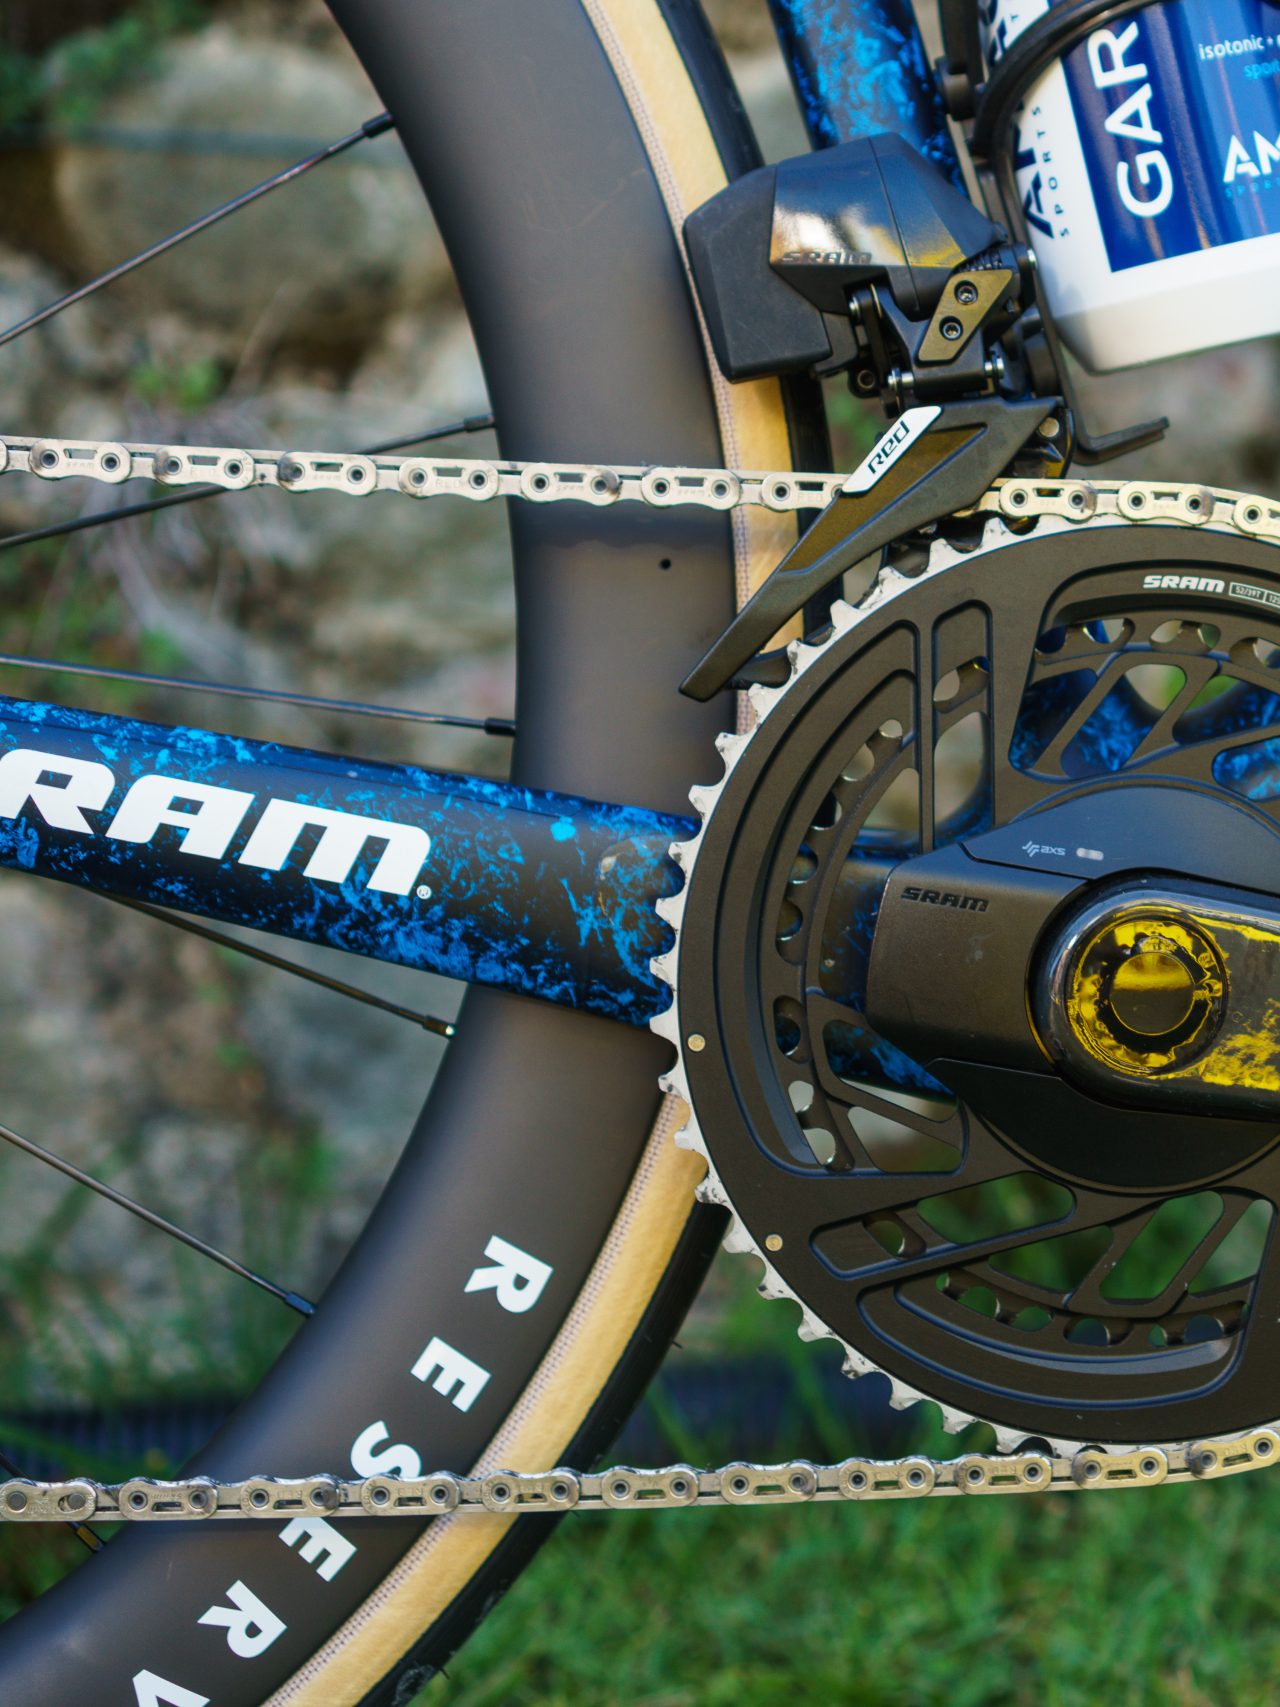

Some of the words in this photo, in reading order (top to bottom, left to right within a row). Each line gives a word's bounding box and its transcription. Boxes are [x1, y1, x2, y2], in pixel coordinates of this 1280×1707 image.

[1198, 33, 1265, 60] isotonic
[1244, 58, 1280, 80] sport
[1032, 105, 1070, 237] SPORTS
[1143, 575, 1225, 593] SRAM
[901, 886, 989, 912] SRAM
